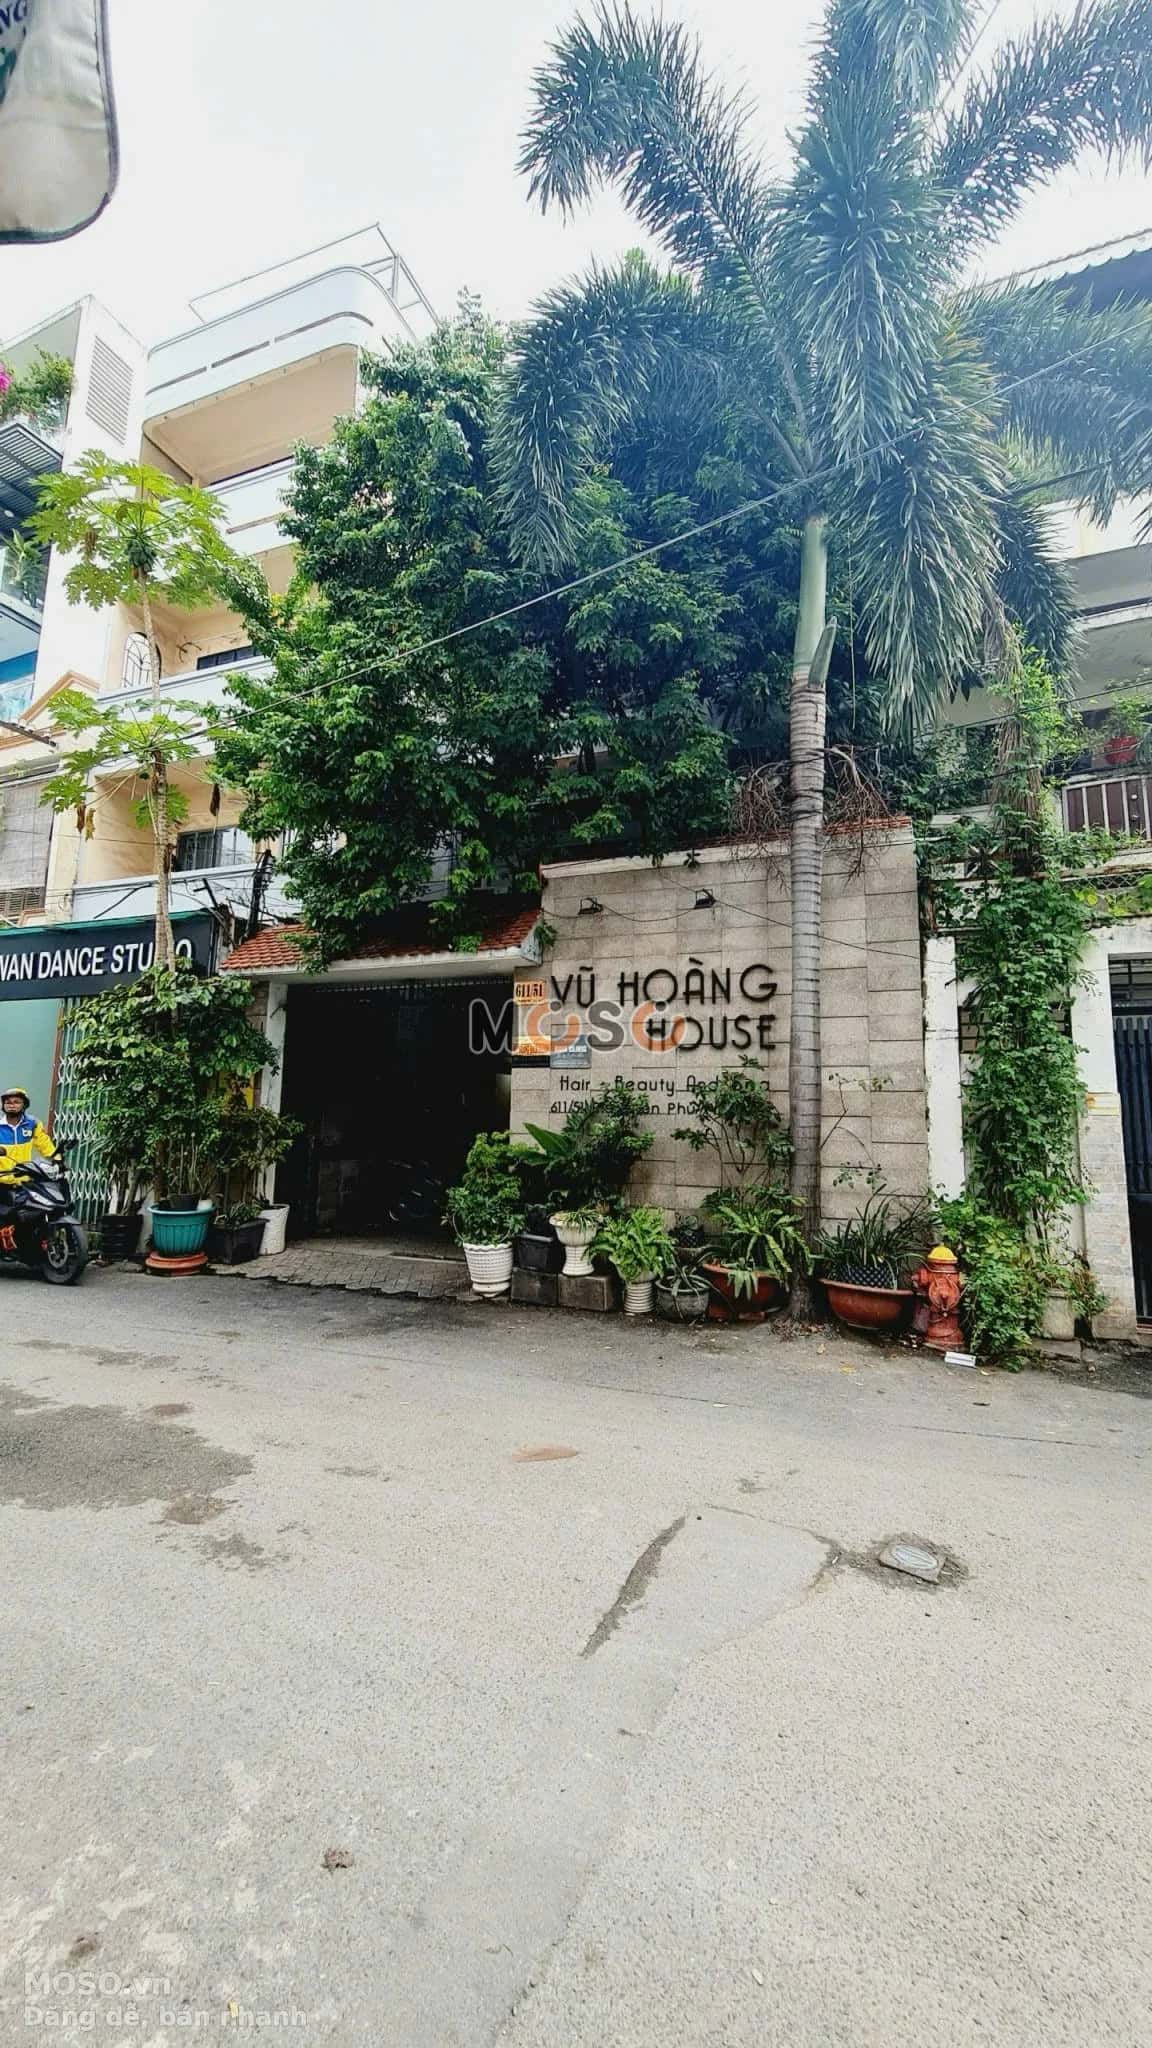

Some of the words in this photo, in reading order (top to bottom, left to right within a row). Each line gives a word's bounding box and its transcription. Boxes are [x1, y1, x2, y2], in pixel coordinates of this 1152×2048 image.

[0, 951, 34, 981] VAN
[37, 946, 106, 979] DANCE
[110, 938, 193, 974] STUO
[550, 965, 596, 1008] VŨ
[617, 957, 778, 1007] HOÀNG
[645, 1013, 777, 1051] HOUSE
[559, 1075, 591, 1091] Hair
[614, 1075, 675, 1097] Beauty
